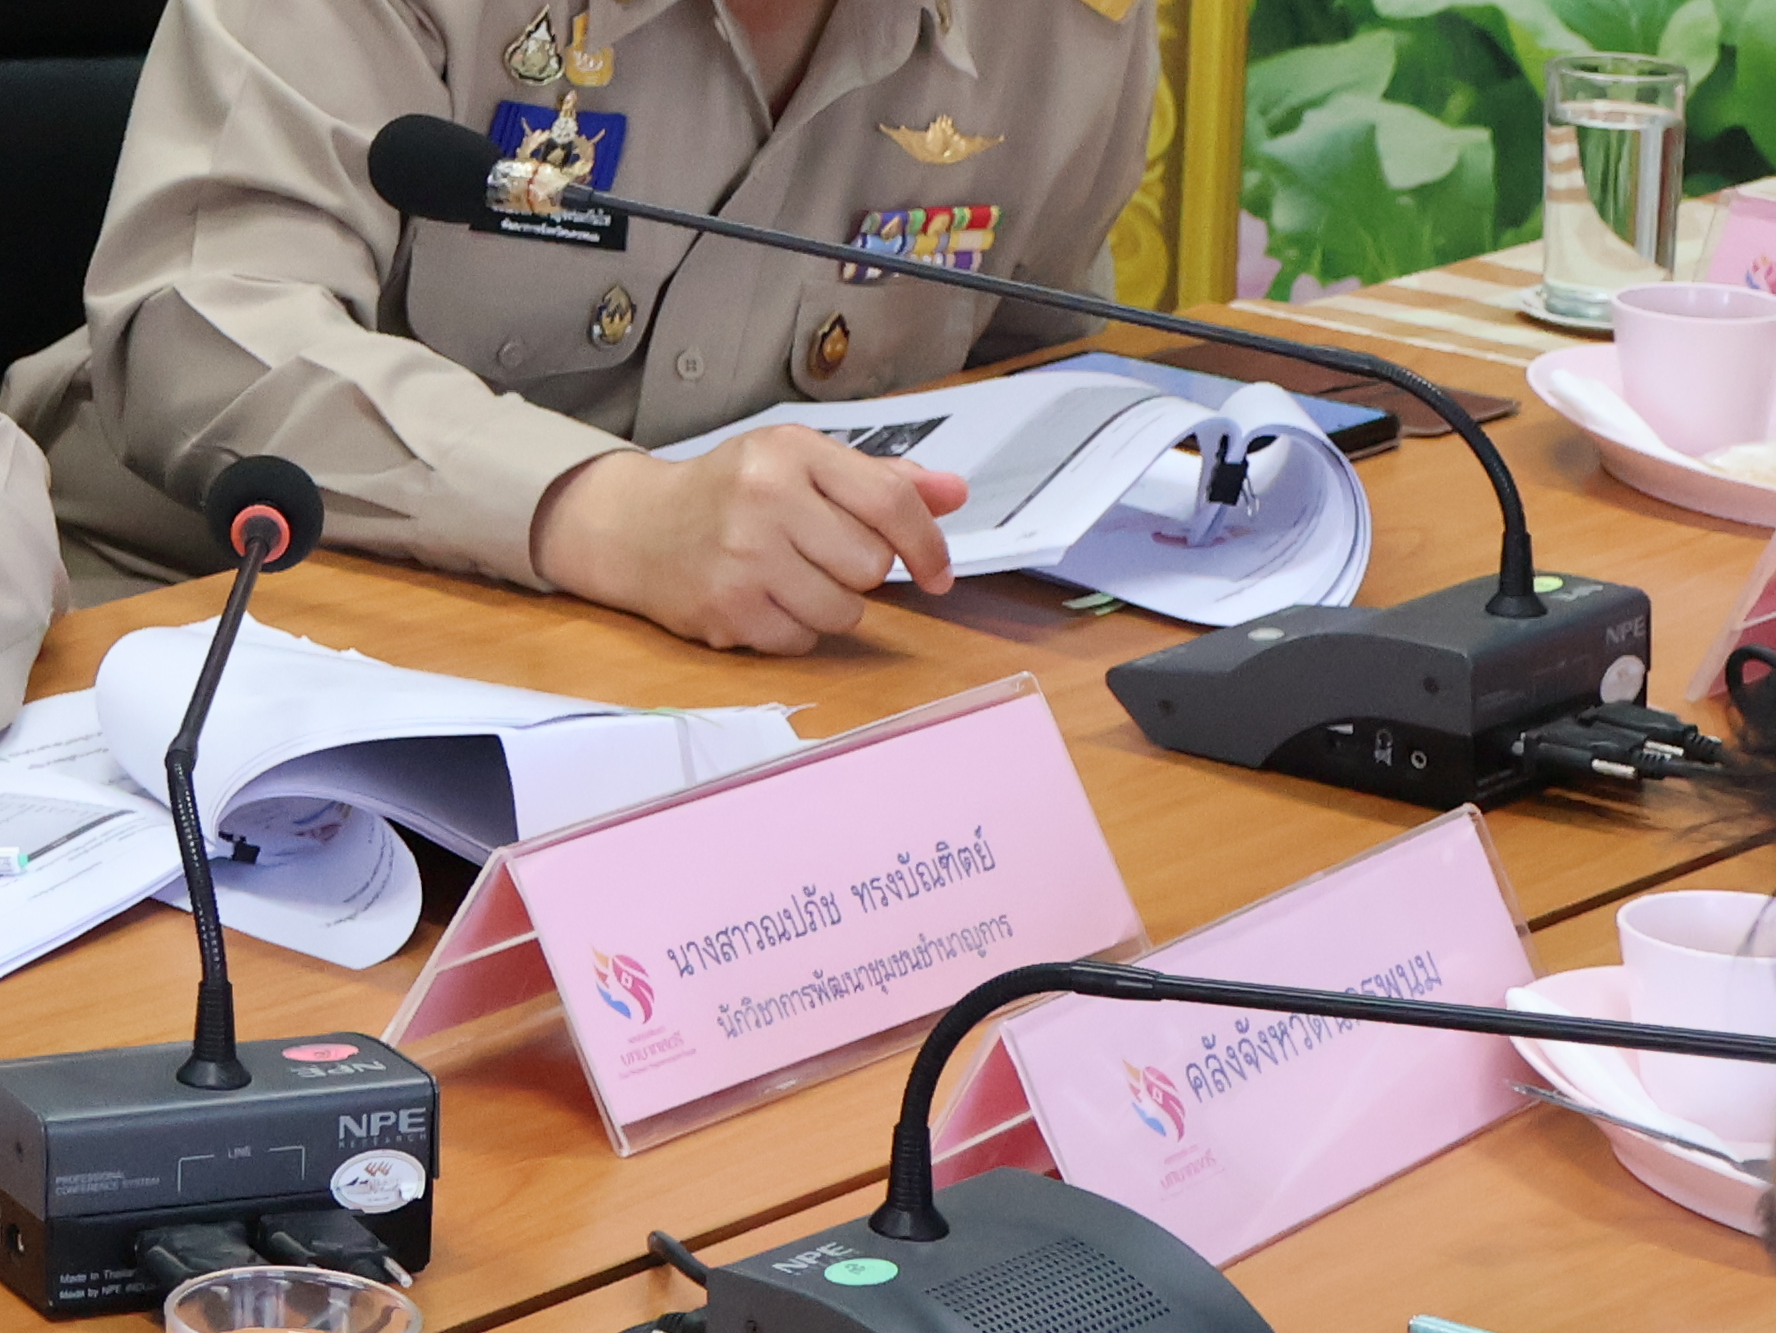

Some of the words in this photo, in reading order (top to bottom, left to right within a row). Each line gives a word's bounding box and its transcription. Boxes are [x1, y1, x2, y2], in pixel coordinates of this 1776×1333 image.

[667, 884, 842, 979] นางสาวณปภัช
[851, 824, 997, 913] ทรงบัณฑิตย์
[716, 913, 1014, 1039] นักวิชาการพัฒนาชุมชนชำนาญการ
[338, 1107, 427, 1140] NPE
[771, 1240, 852, 1275] NPE
